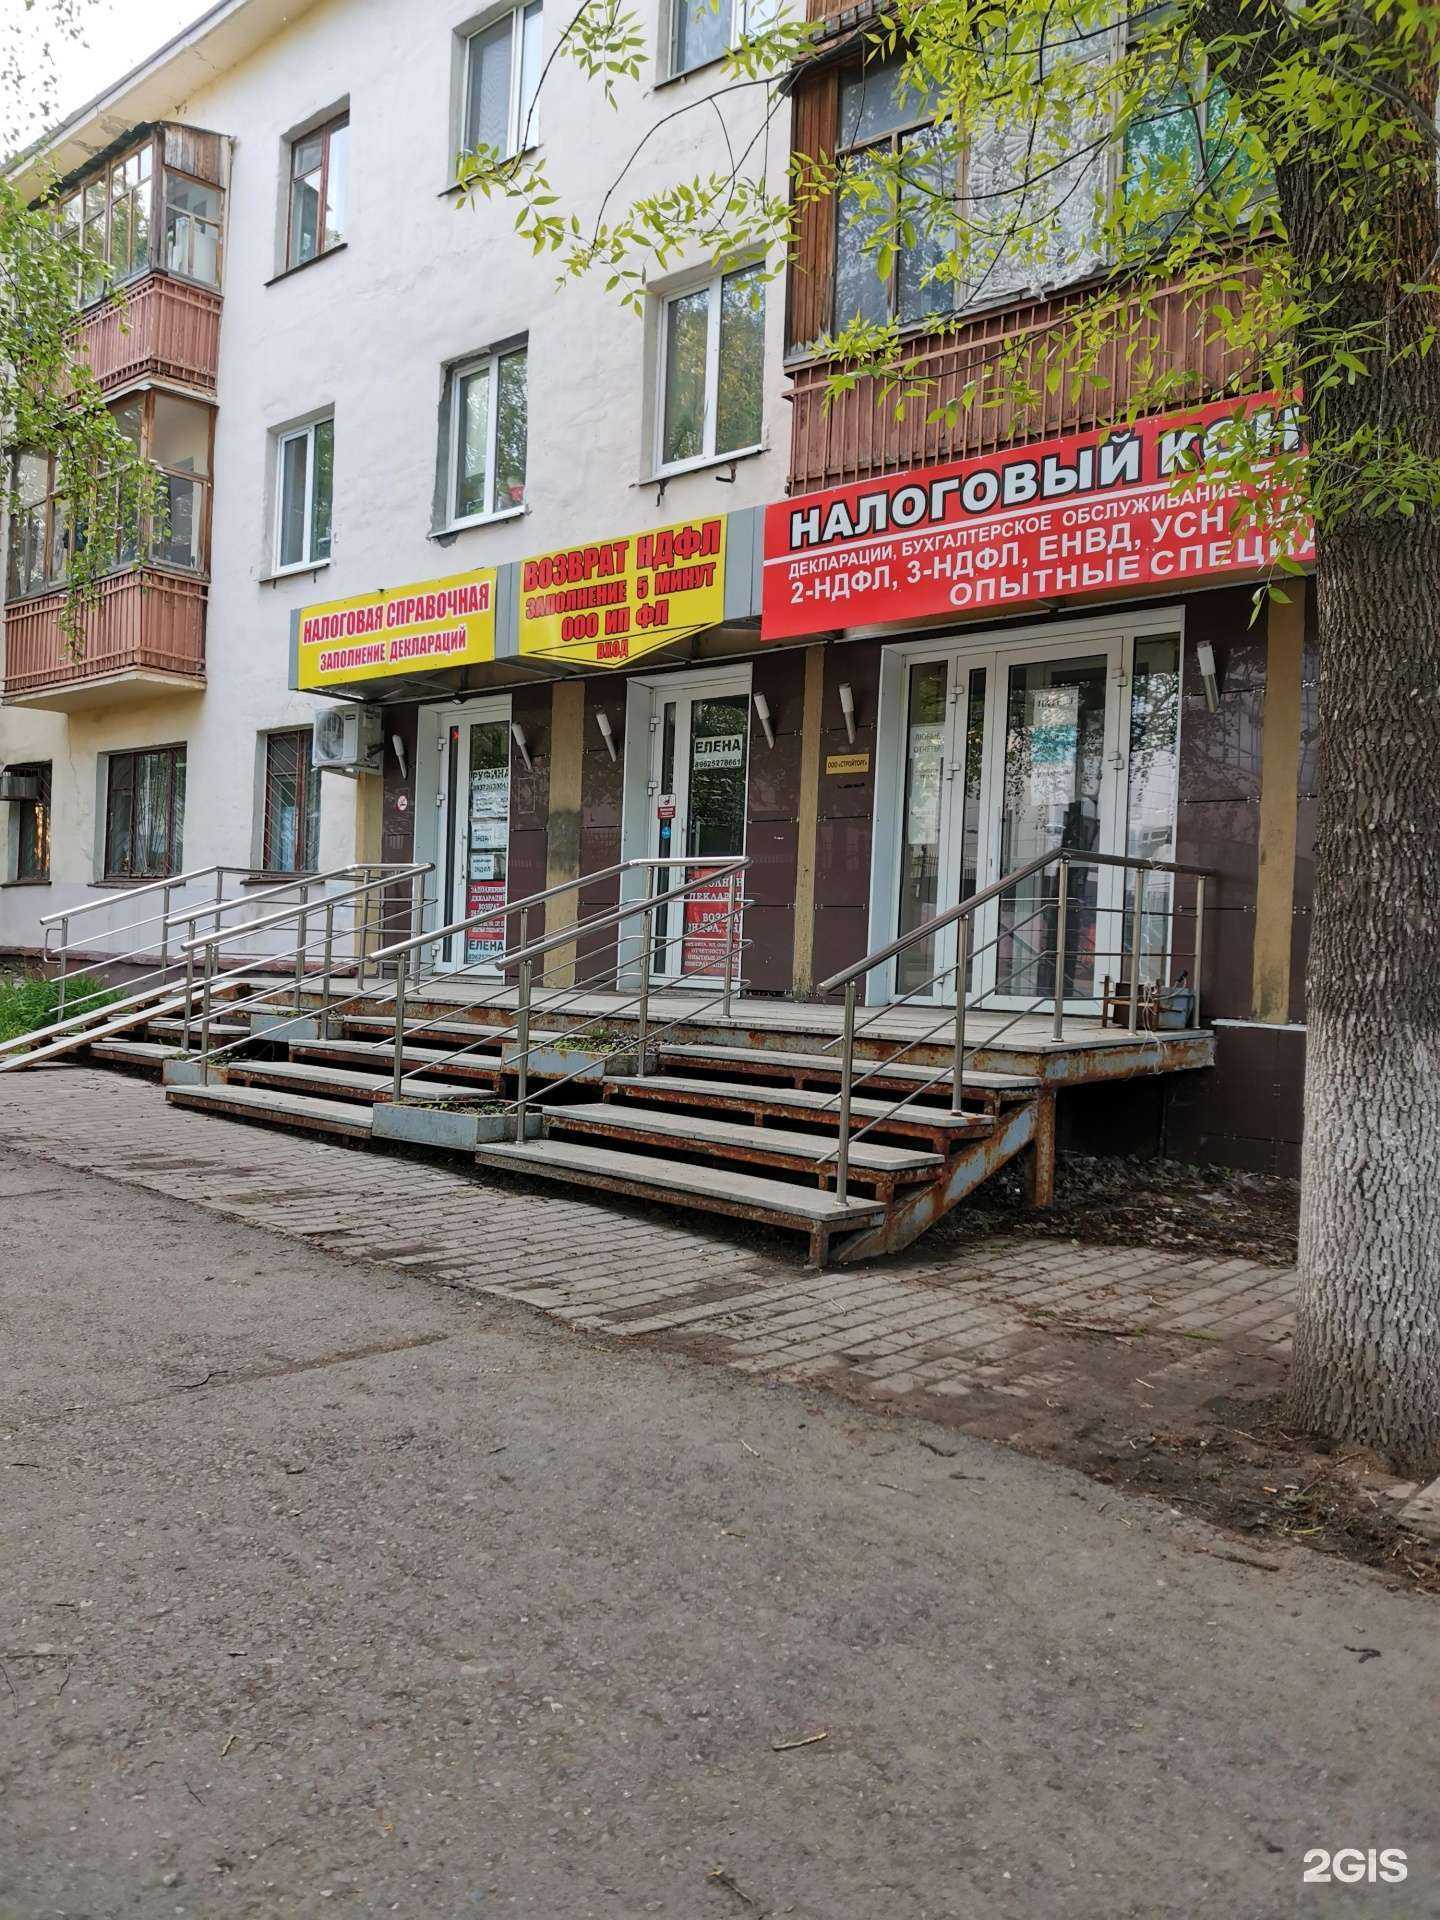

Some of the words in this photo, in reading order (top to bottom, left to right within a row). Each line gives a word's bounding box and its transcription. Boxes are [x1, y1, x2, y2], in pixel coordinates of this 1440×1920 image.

[790, 429, 1143, 550] НАЛОГОВЫЙ
[524, 540, 629, 592] ВОЗВРАТ
[636, 520, 722, 571] НДФЛ
[789, 546, 897, 580] ДЕКЛАРАЦИИ,
[902, 514, 1052, 557] БУХГАЛТЕРСКОЕ
[1063, 480, 1247, 526] ОБСЛУЖИВАНИЕ,
[790, 565, 898, 604] 2-НДФЛ,
[907, 541, 1027, 584] 3-НДФЛ,
[1039, 523, 1141, 561] ЕНВД,
[950, 555, 1140, 606] ОПЫТНЫЕ
[303, 604, 385, 645] НАЛОГОВАЯ
[387, 583, 490, 628] СПРАВОЧНАЯ
[526, 579, 628, 620] ЗАПОЛНЕНИЕ
[637, 575, 649, 600] 5
[654, 562, 717, 596] МИНУТ
[562, 612, 599, 642] ООО
[605, 607, 631, 636] ИП
[635, 599, 669, 629] ФЛ
[320, 643, 386, 672] ЗАПОЛНЕНИЕ
[389, 627, 467, 662] ДЕКЛАРАЦИЙ
[596, 639, 629, 660] ВХОД
[695, 739, 741, 754] ЕЛЕНА
[469, 939, 505, 952] ЕЛЕНА
